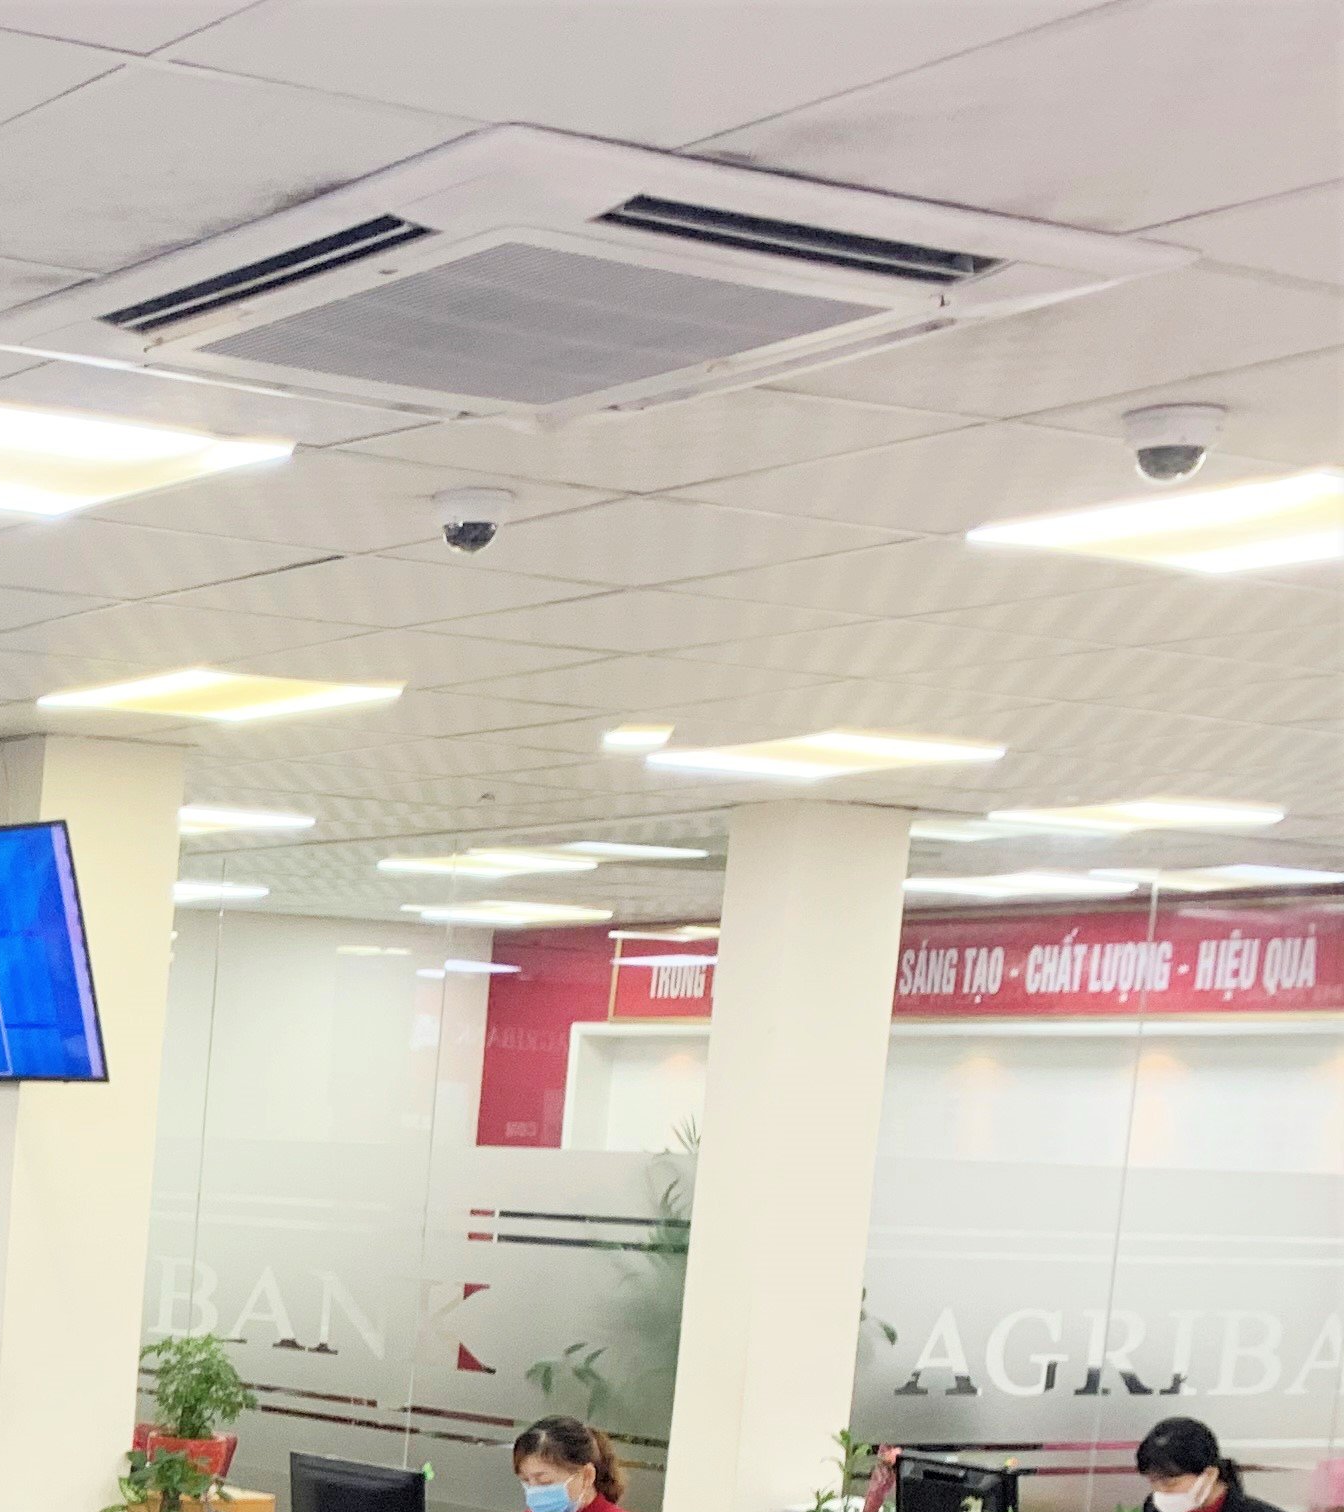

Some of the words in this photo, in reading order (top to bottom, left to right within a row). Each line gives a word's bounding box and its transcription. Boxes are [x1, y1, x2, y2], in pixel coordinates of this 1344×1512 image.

[899, 941, 957, 996] SÁNG
[961, 946, 1005, 1004] TẠO
[1025, 928, 1087, 993] CHẤT
[1088, 941, 1172, 1003] LƯỢNG
[1194, 929, 1261, 1001] HIỆU
